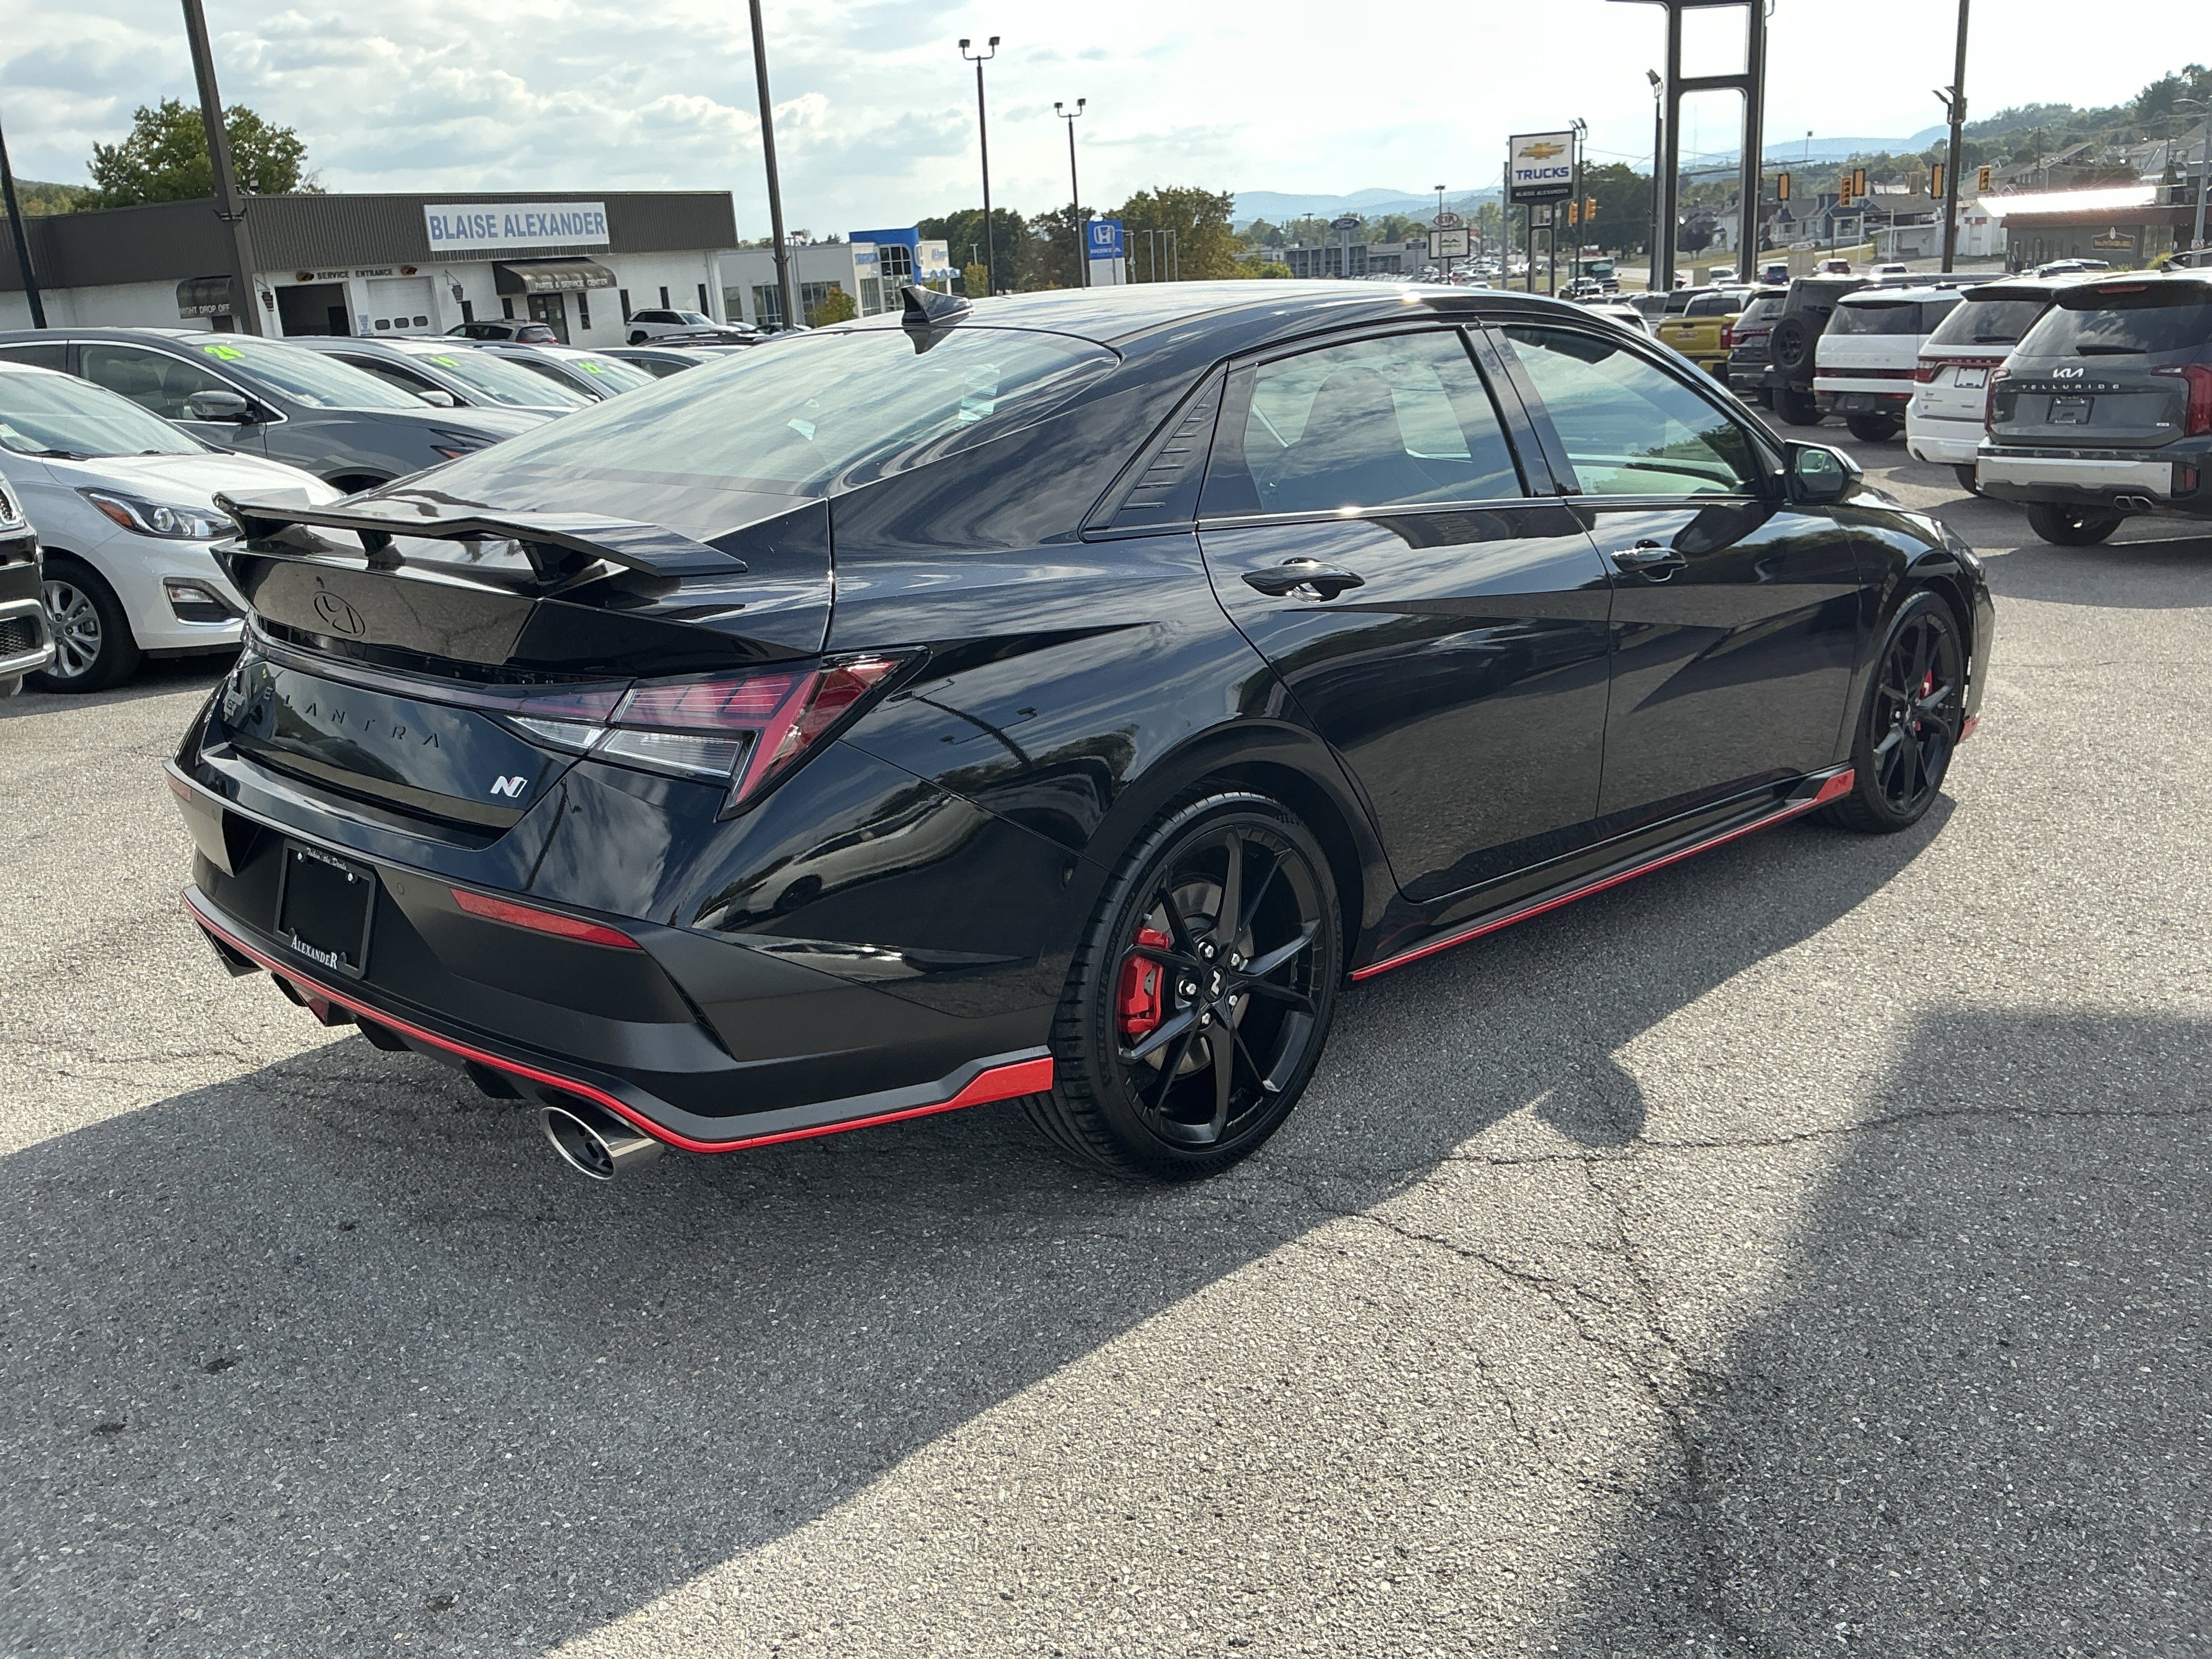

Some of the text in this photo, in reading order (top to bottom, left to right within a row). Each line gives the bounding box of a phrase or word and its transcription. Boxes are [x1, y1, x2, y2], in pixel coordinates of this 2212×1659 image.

[1515, 167, 1569, 180] TRUCKS
[429, 212, 606, 240] BLAISE ALEXANDER
[317, 268, 393, 279] SERVICE ENTRANCE
[561, 280, 584, 289] SERVICE
[179, 303, 230, 315] NIGHT DROP OFF
[263, 686, 439, 748] ELANTRA
[291, 934, 337, 969] ALEXANDER
[1097, 971, 1109, 1063] MICHELIN
